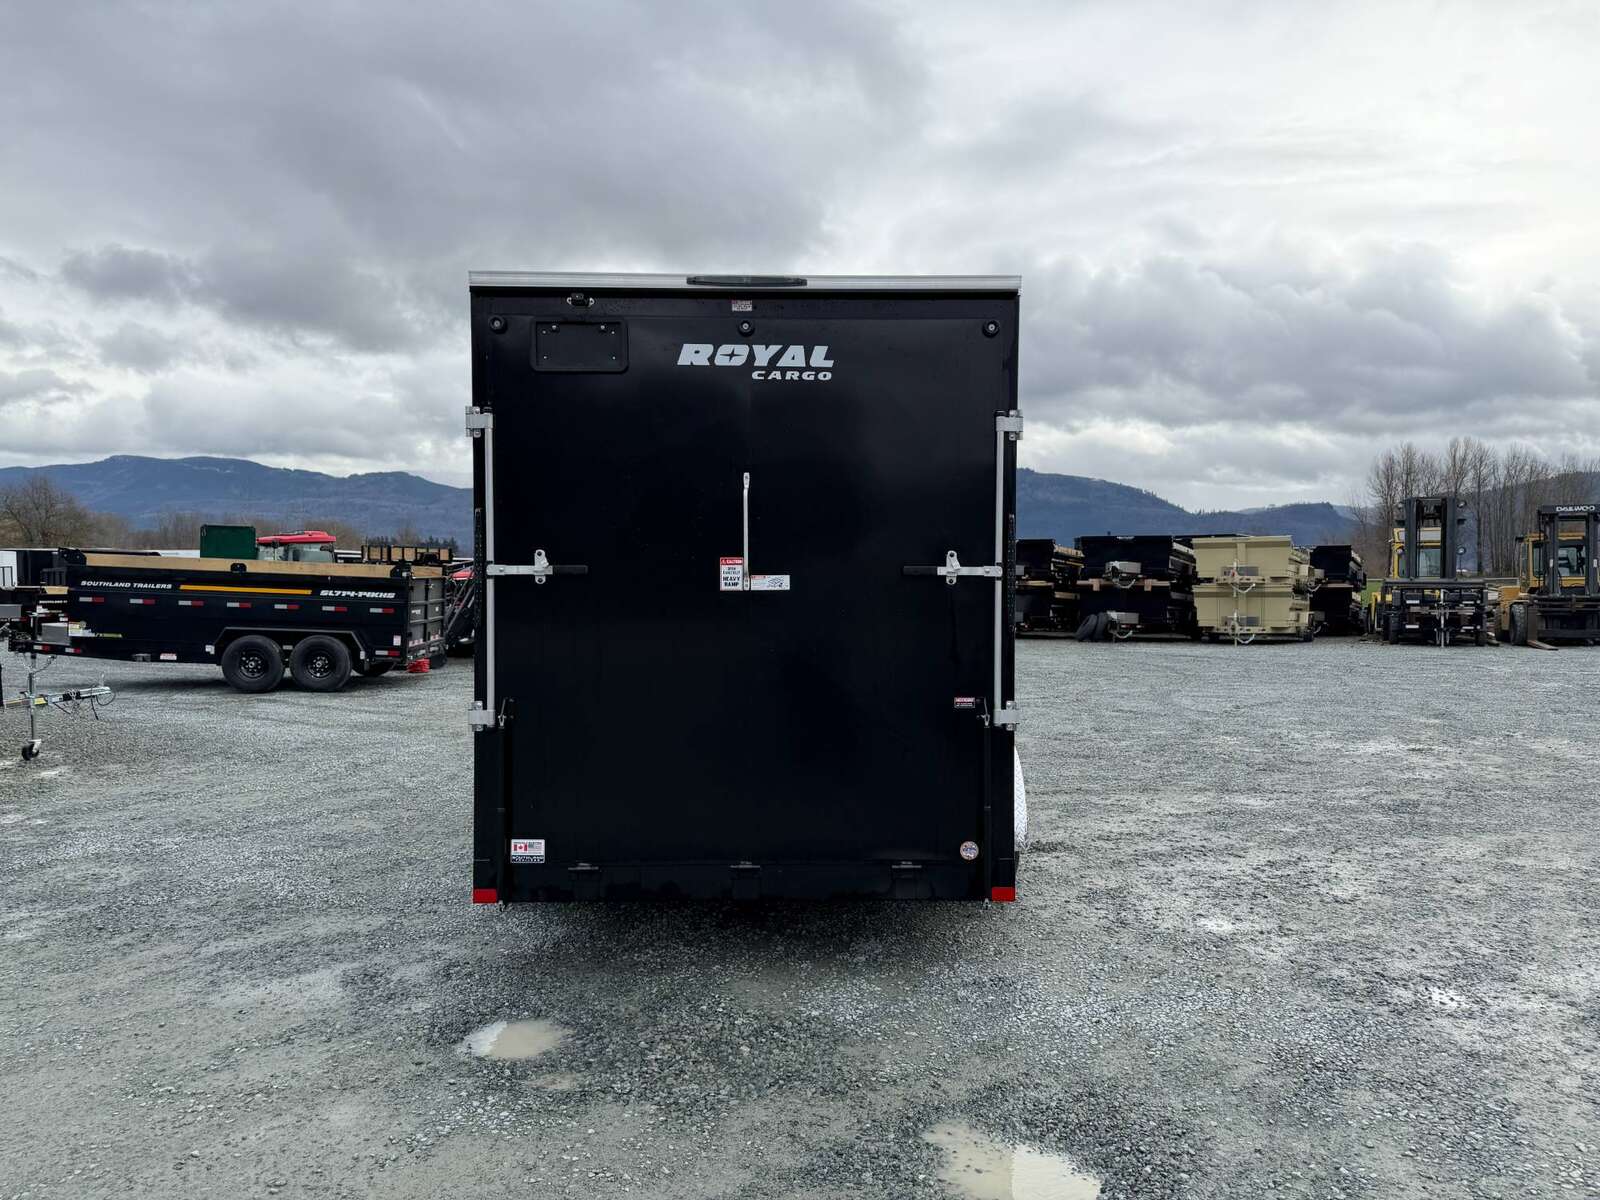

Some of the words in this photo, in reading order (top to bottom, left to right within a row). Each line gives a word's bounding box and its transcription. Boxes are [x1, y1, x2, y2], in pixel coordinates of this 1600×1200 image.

[677, 343, 834, 368] ROYAL
[751, 371, 832, 381] CARGO
[80, 580, 131, 588] SOUTHLAND
